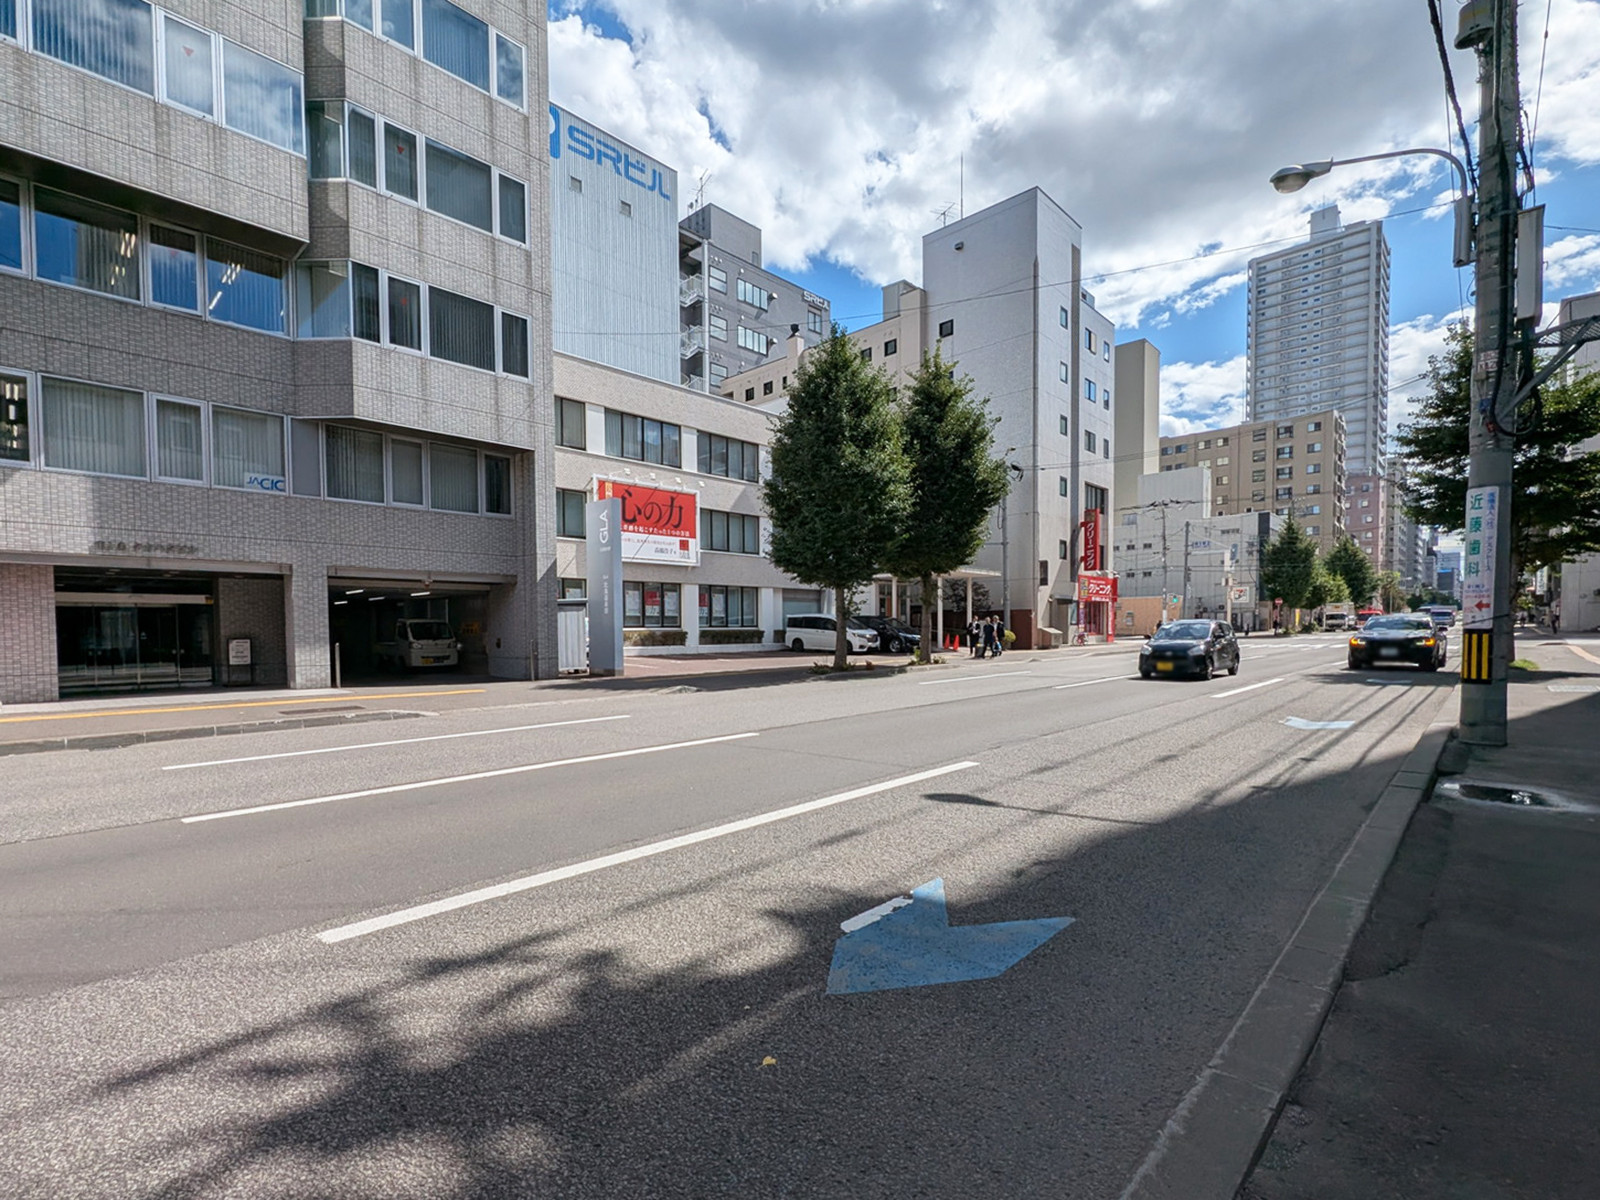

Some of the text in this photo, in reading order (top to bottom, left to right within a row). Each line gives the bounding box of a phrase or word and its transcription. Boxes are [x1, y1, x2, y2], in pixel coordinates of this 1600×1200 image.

[567, 125, 671, 202] SRビル
[247, 476, 285, 492] JACIC
[600, 509, 609, 544] GLA
[621, 490, 684, 529] 心の力
[1086, 522, 1095, 570] クリーニング
[1468, 493, 1483, 577] 近藤歯科
